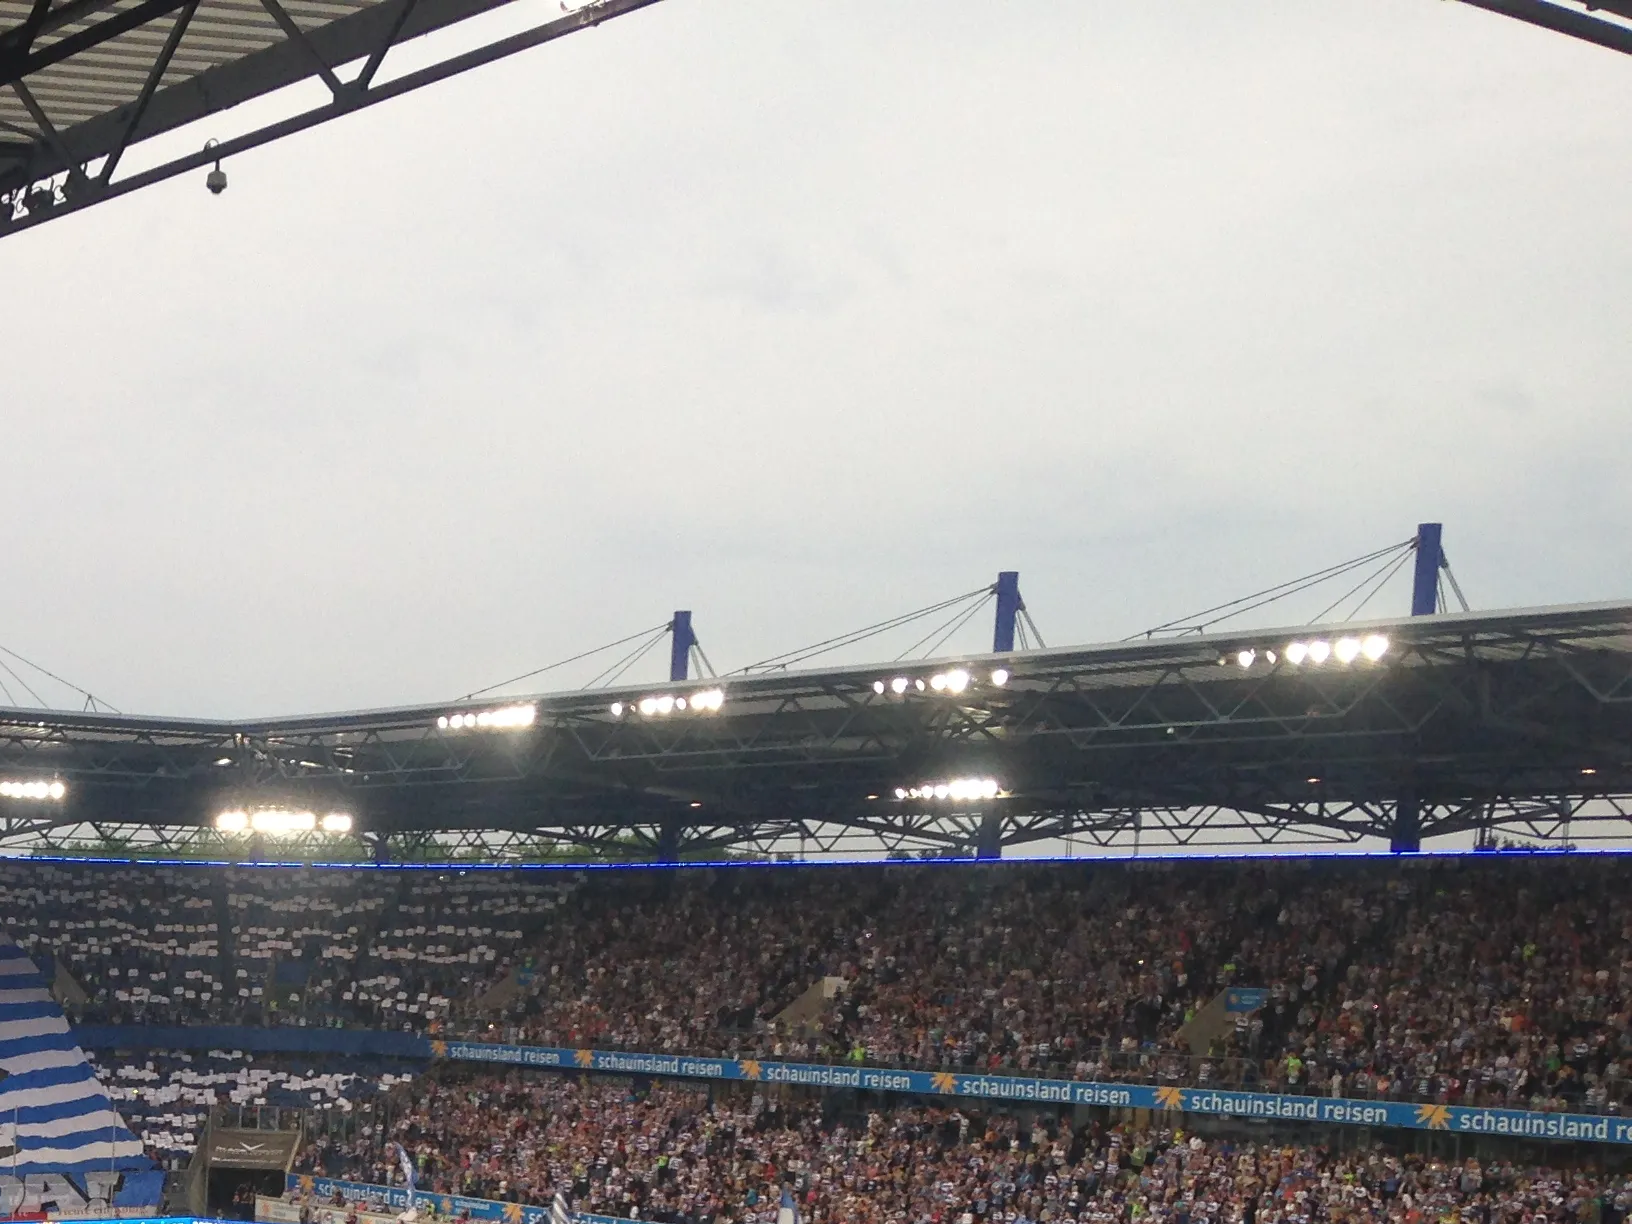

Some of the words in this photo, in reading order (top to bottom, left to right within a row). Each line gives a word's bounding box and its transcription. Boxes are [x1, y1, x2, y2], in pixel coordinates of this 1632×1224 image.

[450, 1043, 520, 1062] schauinsland
[523, 1050, 559, 1065] reisen
[598, 1053, 678, 1073] schauinsland
[682, 1058, 722, 1077] reisen
[767, 1062, 859, 1087] schauinsland
[864, 1069, 910, 1090] reisen
[962, 1074, 1063, 1101] schauinsland
[1068, 1083, 1130, 1105] reisen
[1191, 1093, 1317, 1120] schauinsland
[1324, 1101, 1388, 1124] reisen
[1460, 1110, 1609, 1141] schauinsland
[319, 1181, 390, 1205] schuinsland
